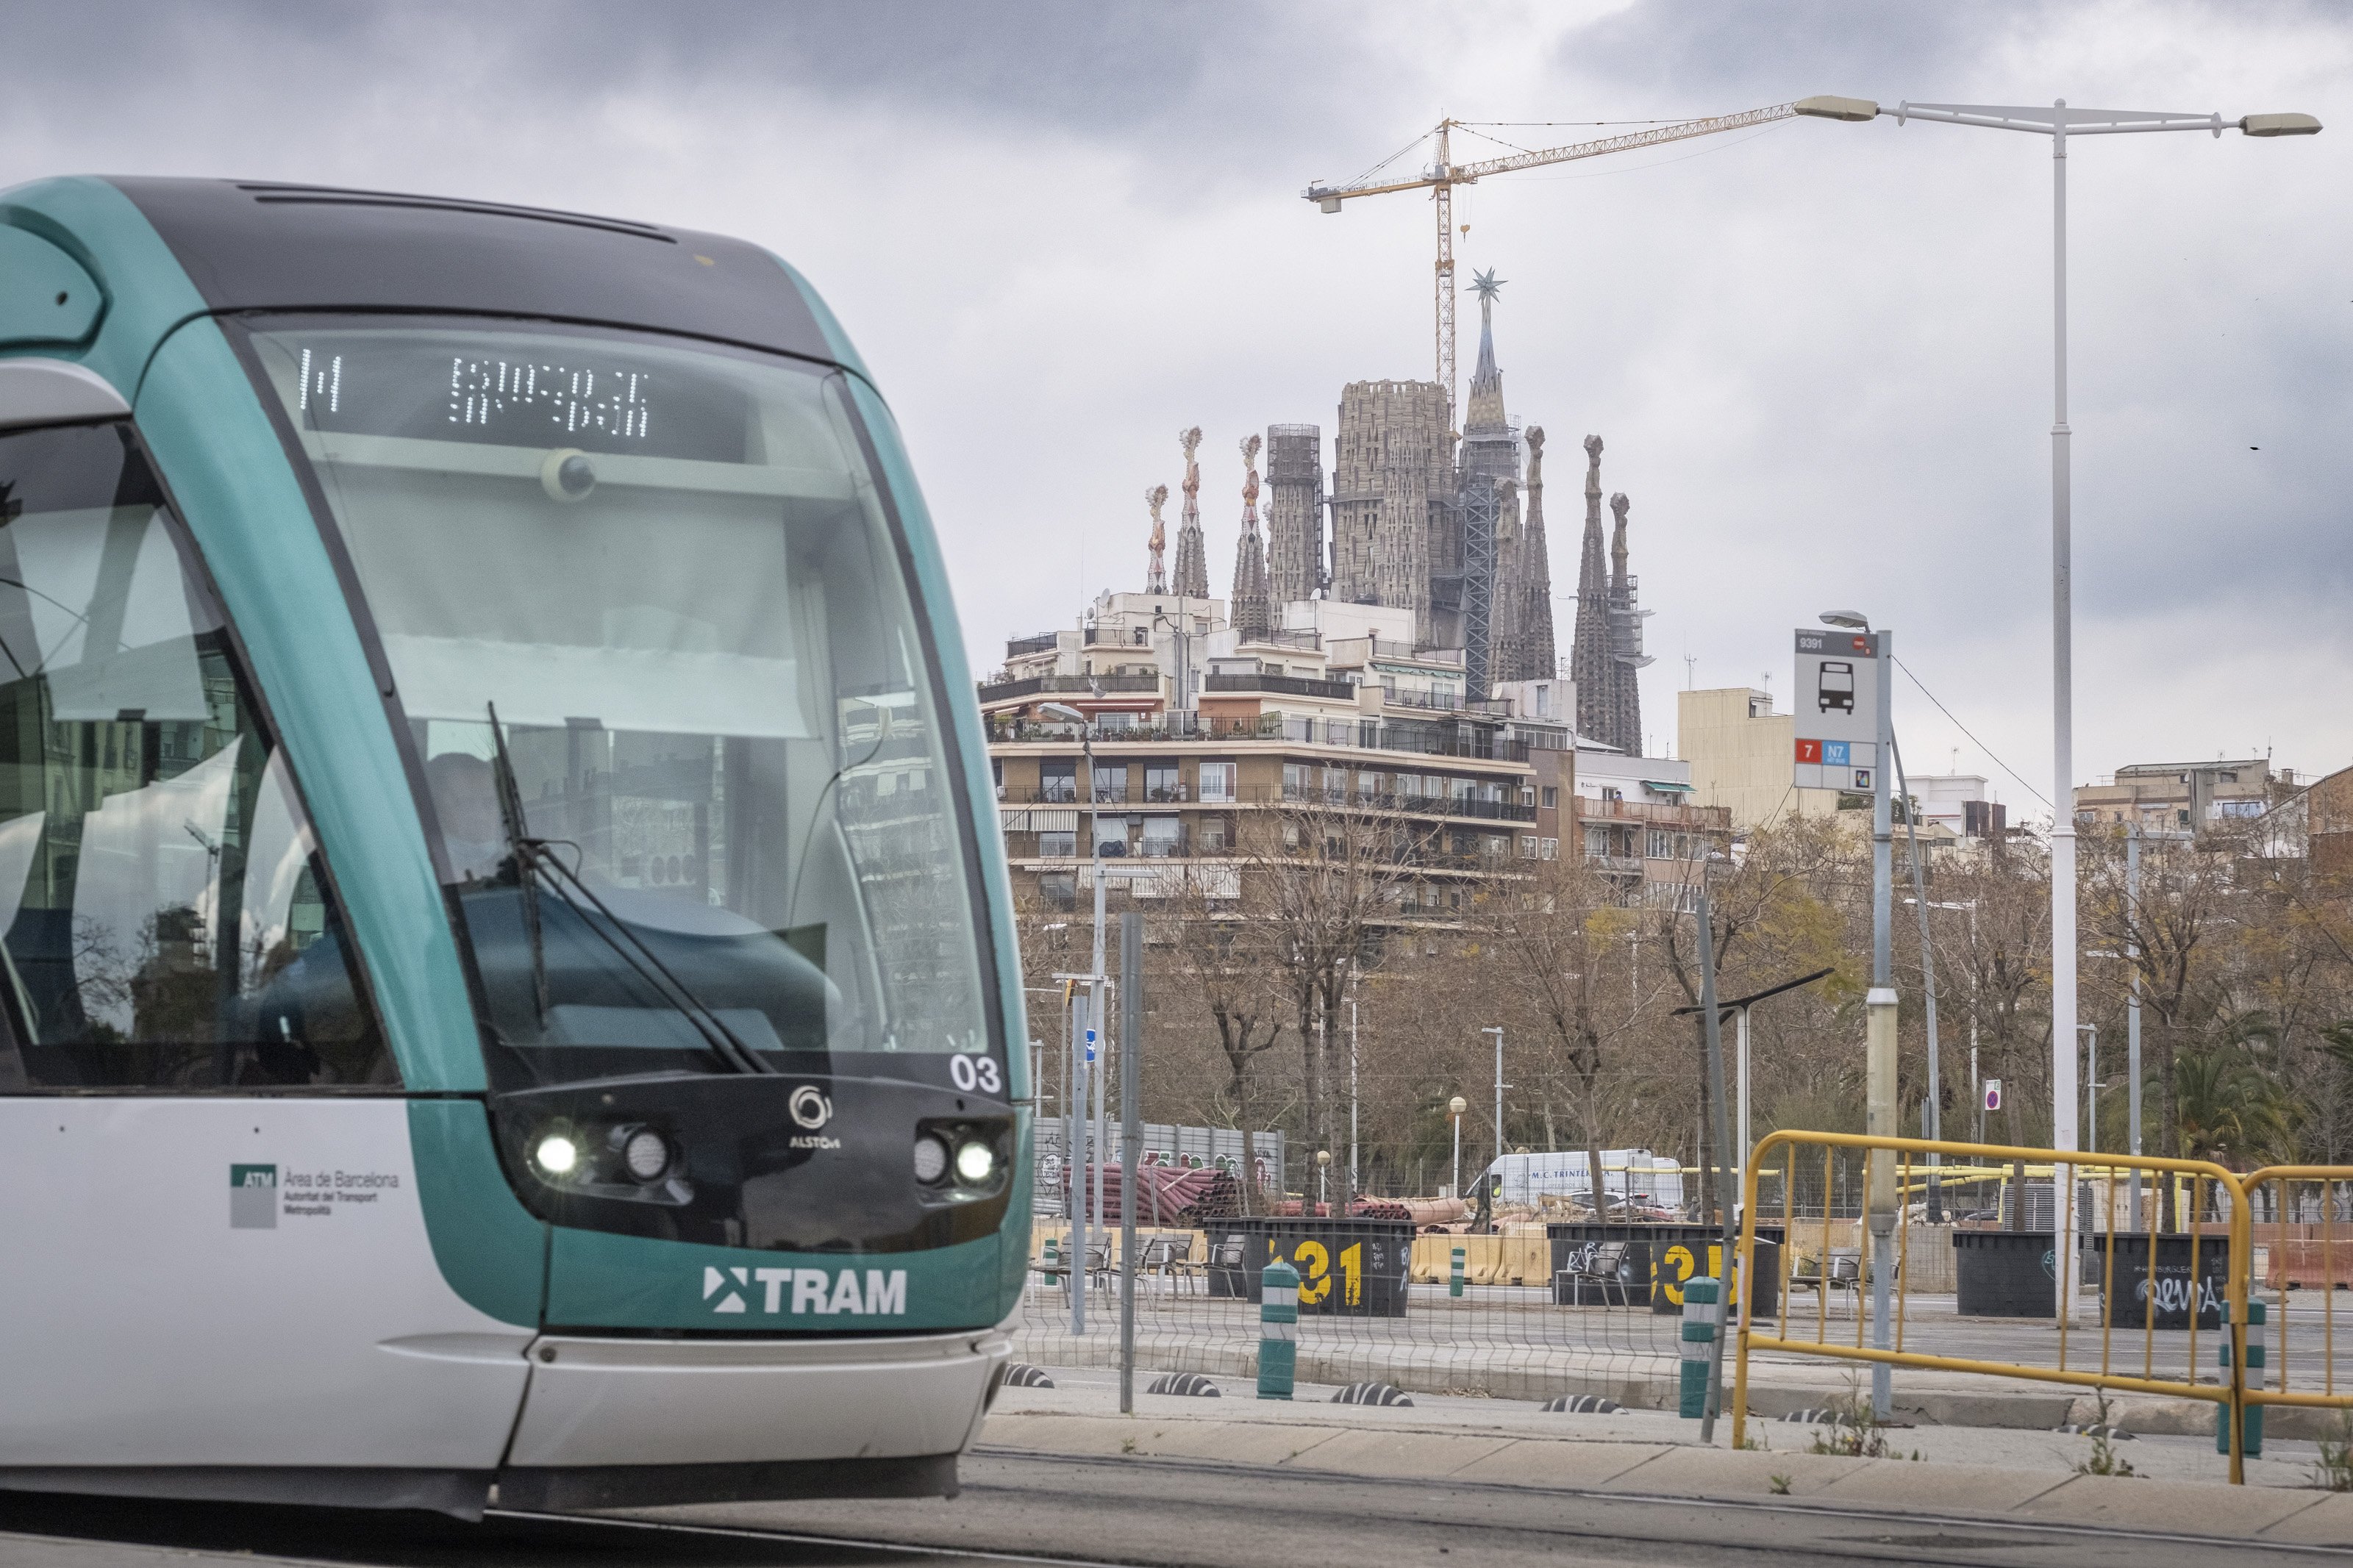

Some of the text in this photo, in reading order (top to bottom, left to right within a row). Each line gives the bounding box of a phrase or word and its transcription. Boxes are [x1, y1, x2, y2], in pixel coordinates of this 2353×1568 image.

[1800, 637, 1822, 649] 9391
[1804, 745, 1813, 758] 7
[1828, 745, 1844, 758] N7
[950, 1053, 1001, 1093] 03
[243, 1172, 274, 1188] ATM
[316, 1171, 331, 1187] de
[335, 1170, 399, 1188] Barcelona
[323, 1192, 334, 1202] del
[337, 1191, 377, 1203] Transport
[755, 1267, 907, 1314] TRAM
